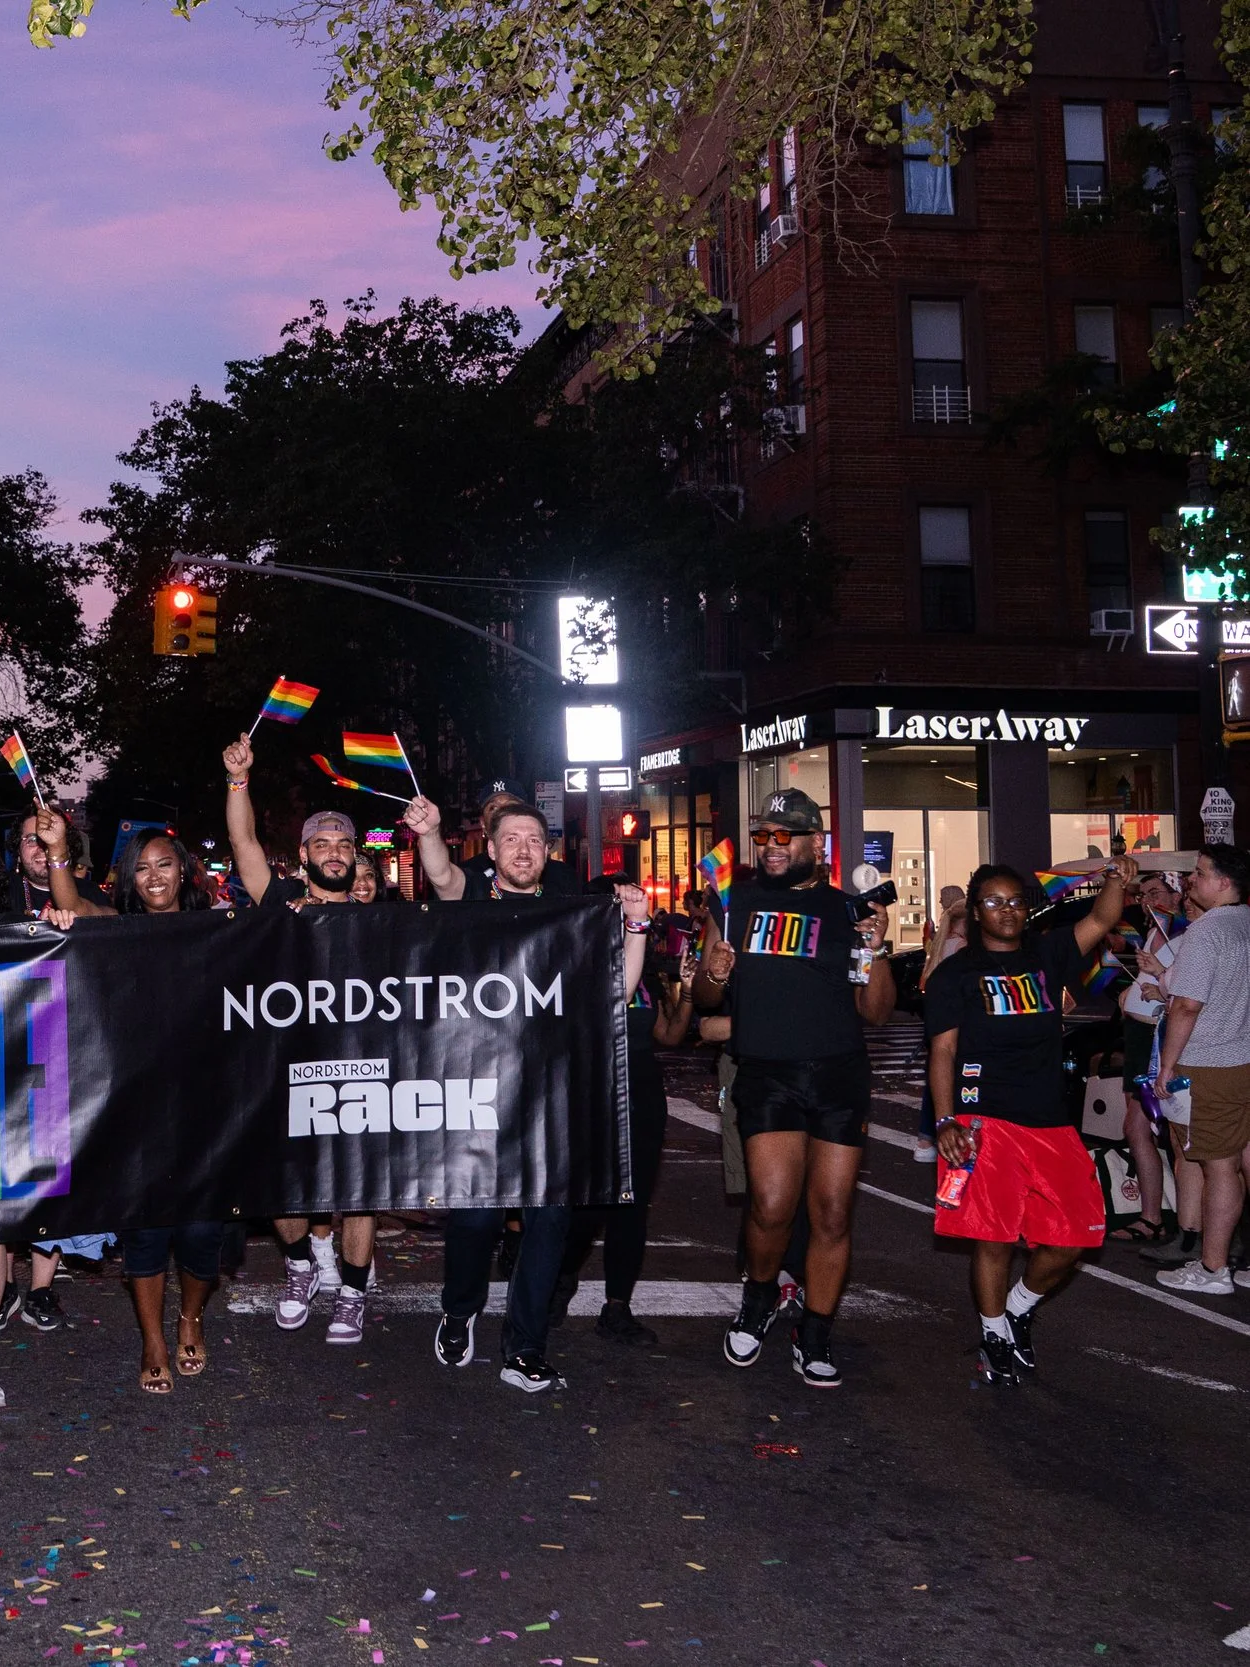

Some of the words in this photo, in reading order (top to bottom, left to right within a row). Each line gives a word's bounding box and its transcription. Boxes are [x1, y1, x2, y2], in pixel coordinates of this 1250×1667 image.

[1174, 623, 1198, 639] ON
[1224, 623, 1250, 640] WA
[741, 714, 807, 752] LaserAway
[875, 706, 1090, 751] LaserAway
[640, 748, 681, 772] FRAMEBRIDGE
[770, 796, 786, 812] NY
[743, 911, 822, 959] PRIDE
[223, 972, 563, 1031] NORDSTROM
[293, 1062, 387, 1080] NORDSTROM
